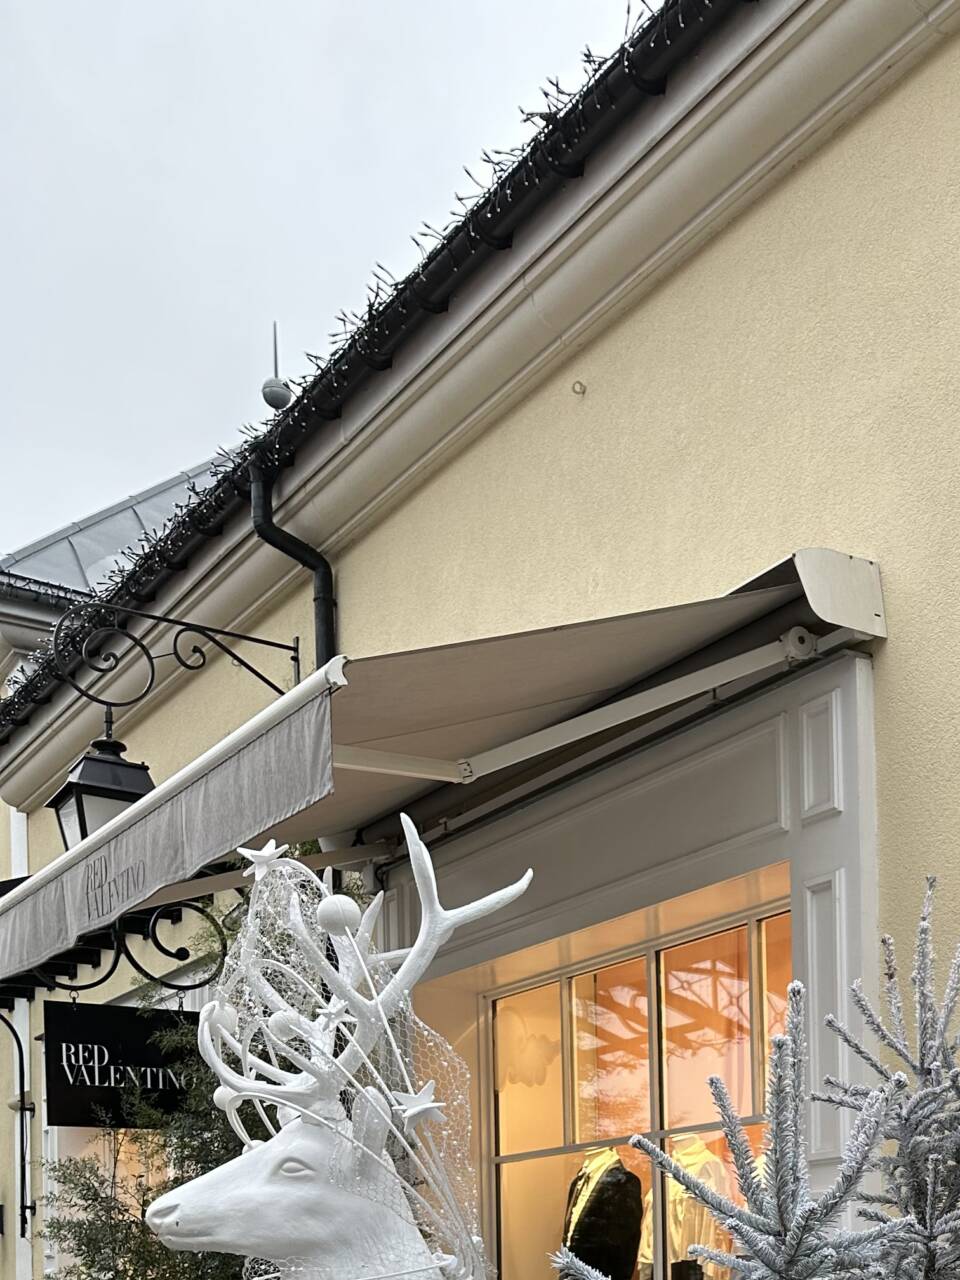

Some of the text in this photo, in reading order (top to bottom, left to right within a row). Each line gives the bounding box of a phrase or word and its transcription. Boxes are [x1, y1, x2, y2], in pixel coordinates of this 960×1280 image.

[85, 855, 108, 895] RED
[86, 860, 146, 920] VALENTINO
[61, 1042, 110, 1067] RED
[63, 1063, 197, 1091] VALENTINO
